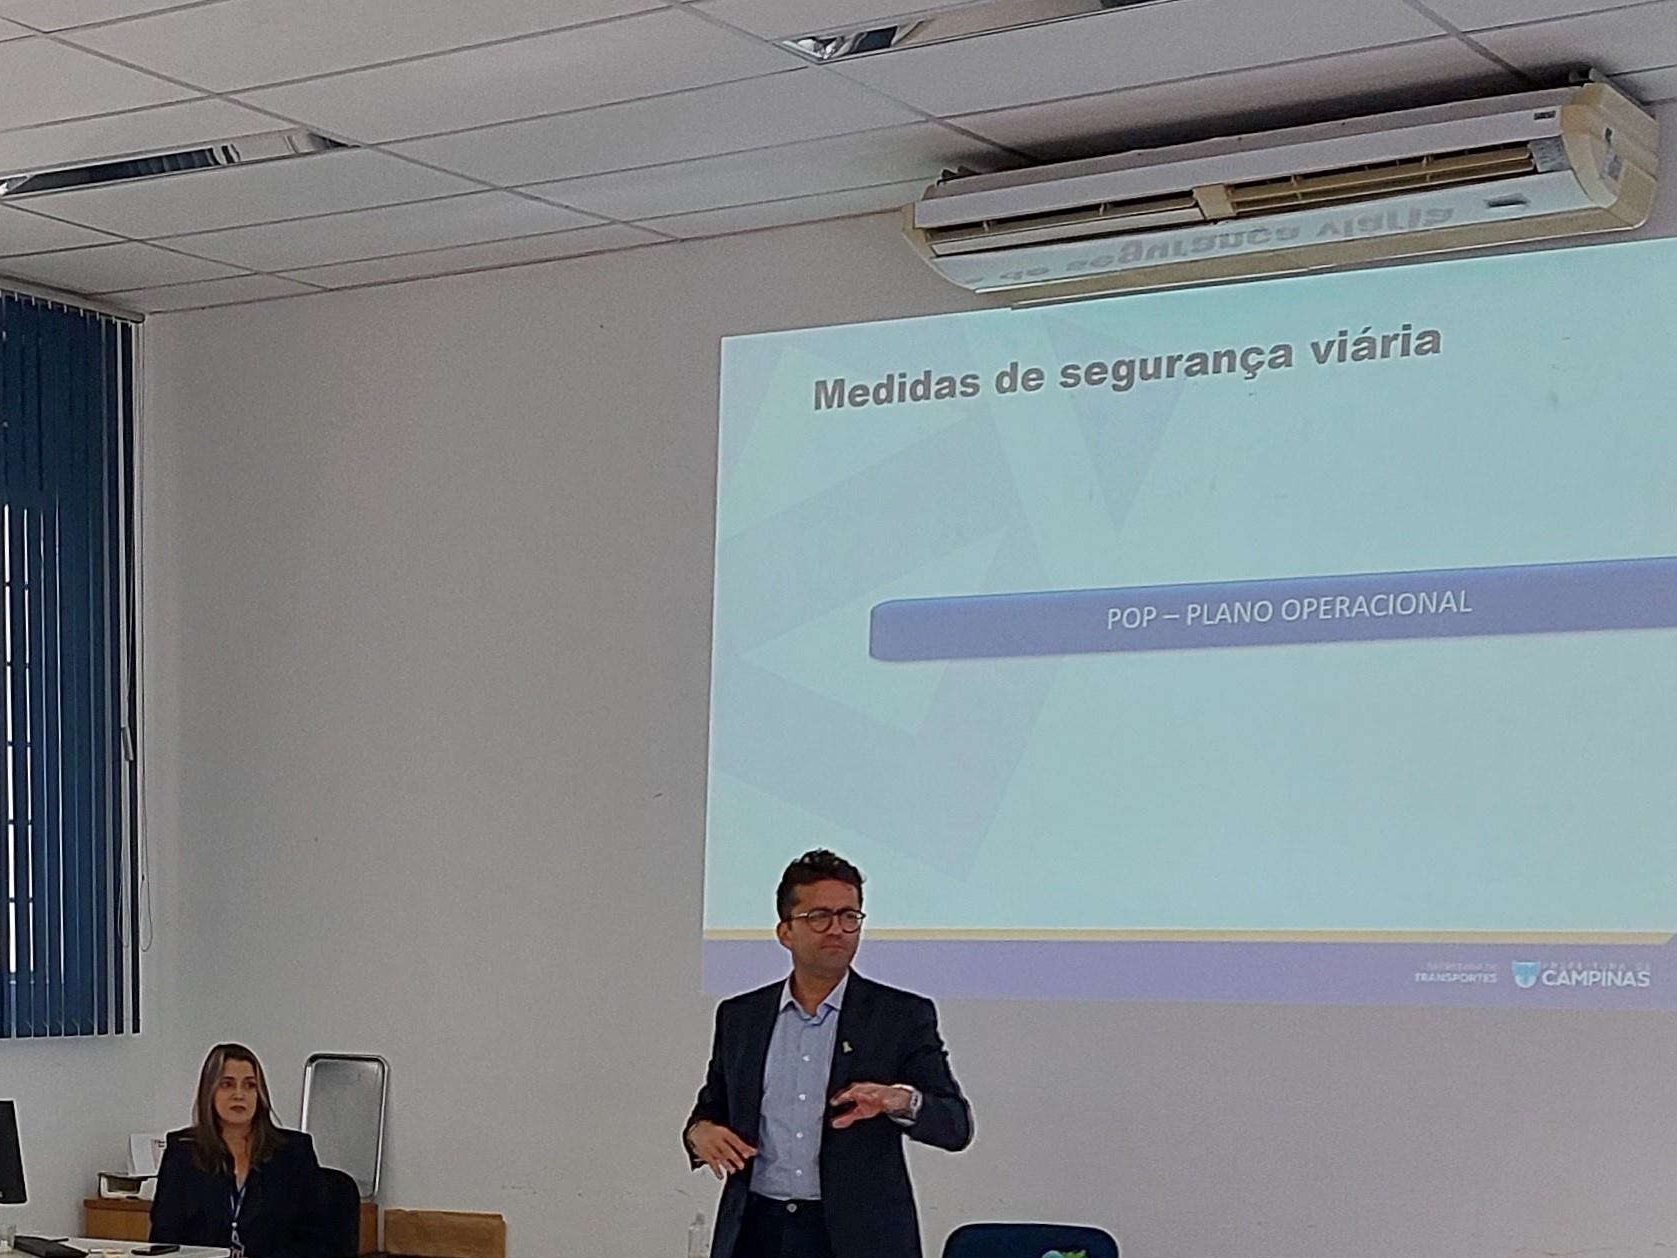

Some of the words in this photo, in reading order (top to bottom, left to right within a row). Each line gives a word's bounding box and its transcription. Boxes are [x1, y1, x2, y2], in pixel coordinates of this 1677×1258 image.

[813, 370, 981, 411] Medidas
[995, 361, 1044, 396] de
[1058, 342, 1294, 392] segurança
[1310, 325, 1443, 366] viária
[1107, 606, 1157, 630] POP
[1186, 600, 1274, 626] PLANO
[1280, 590, 1473, 621] OPERACIONAL
[1414, 972, 1498, 984] TRANSPORTES
[1541, 969, 1652, 988] CAMPINAS
